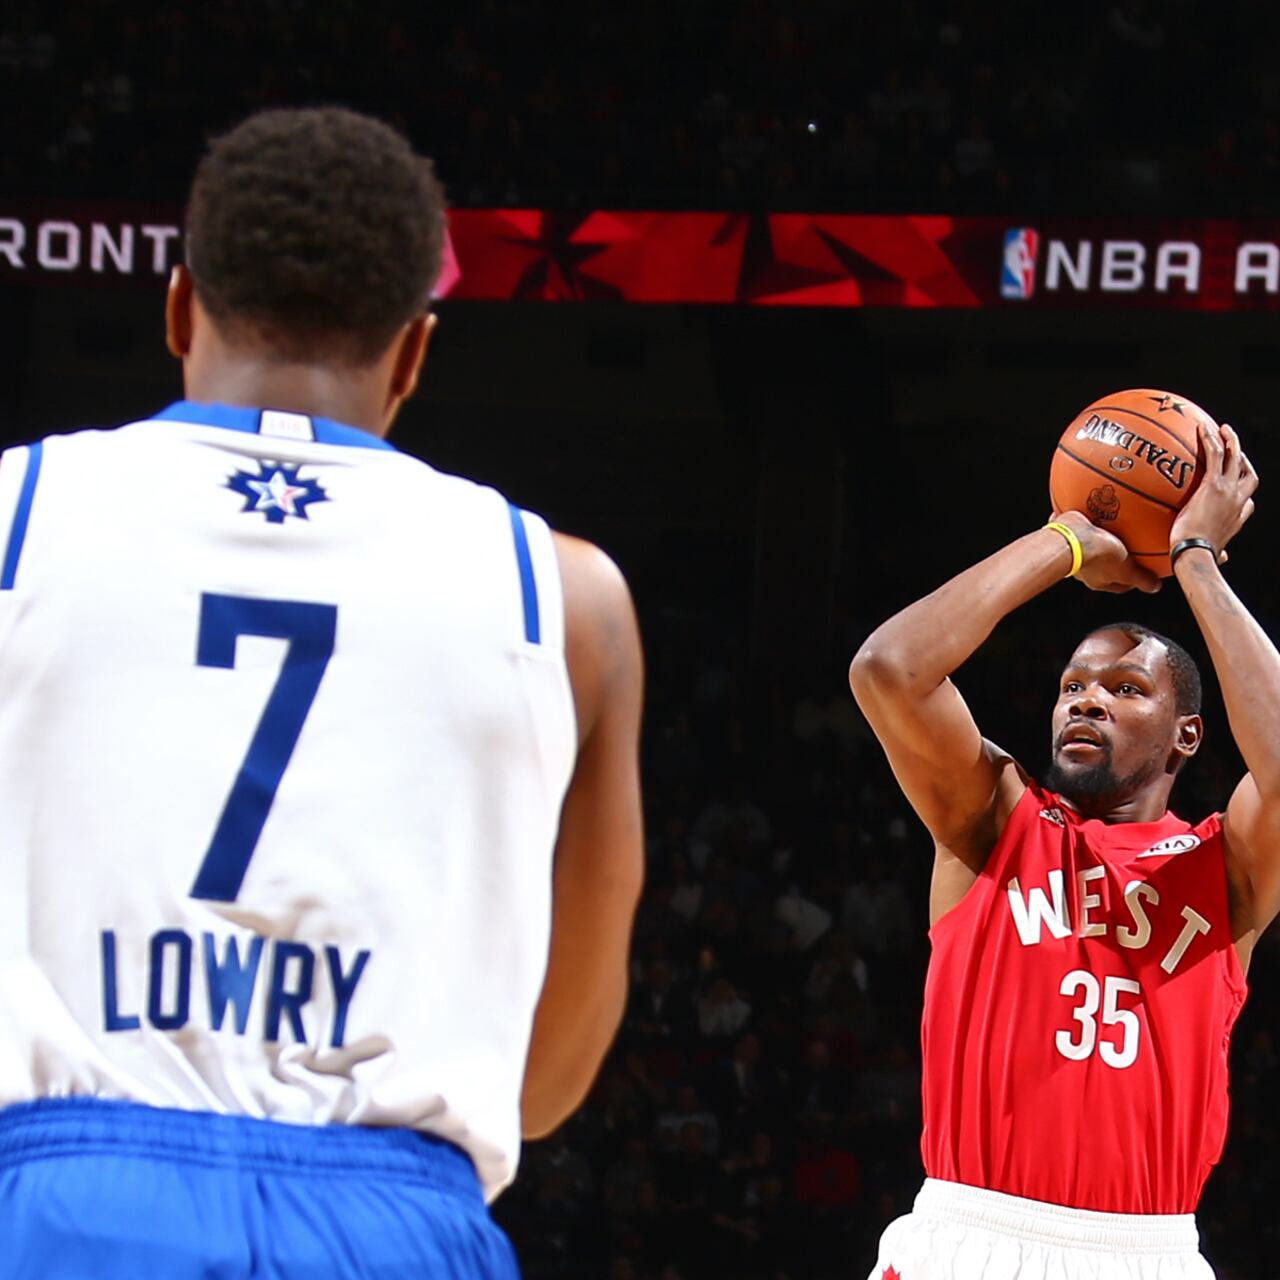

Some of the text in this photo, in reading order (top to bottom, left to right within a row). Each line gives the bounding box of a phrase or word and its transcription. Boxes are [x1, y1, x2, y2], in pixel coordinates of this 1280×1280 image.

[1045, 241, 1201, 292] NBA
[1075, 414, 1194, 489] SPALDING
[189, 592, 338, 903] 7
[1006, 863, 1212, 975] WEST
[100, 928, 372, 1049] LOWRY
[1055, 970, 1141, 1069] 35
